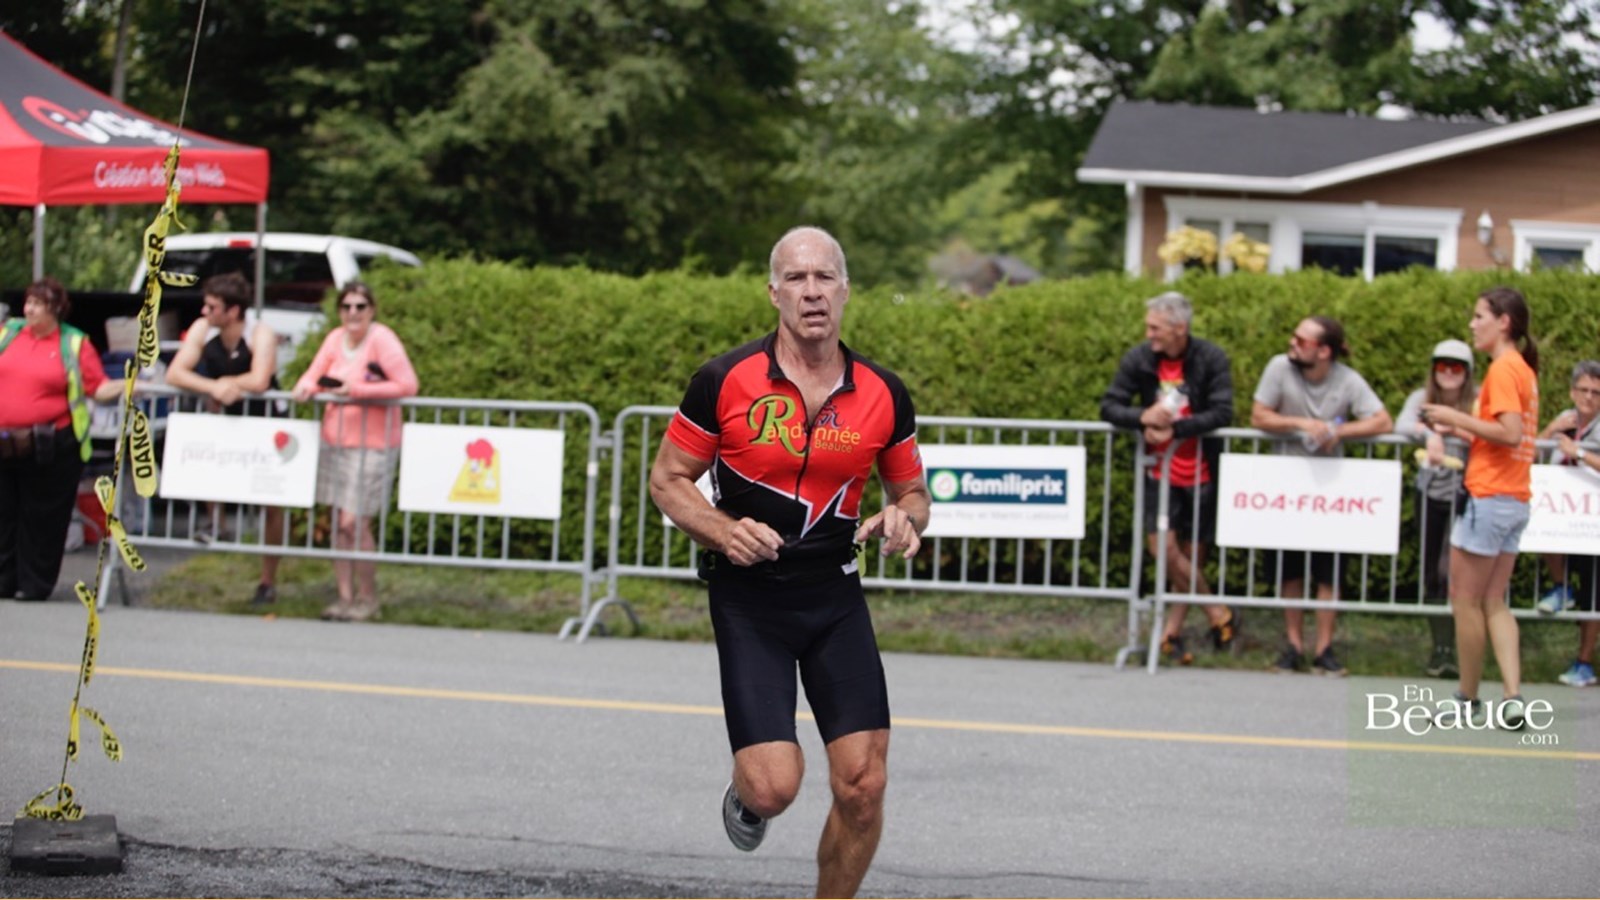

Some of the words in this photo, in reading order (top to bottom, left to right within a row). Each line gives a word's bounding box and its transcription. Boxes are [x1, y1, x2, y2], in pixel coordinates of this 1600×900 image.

[748, 393, 861, 457] Randnnée
[815, 439, 853, 454] Beauce
[960, 471, 1063, 501] familiprix
